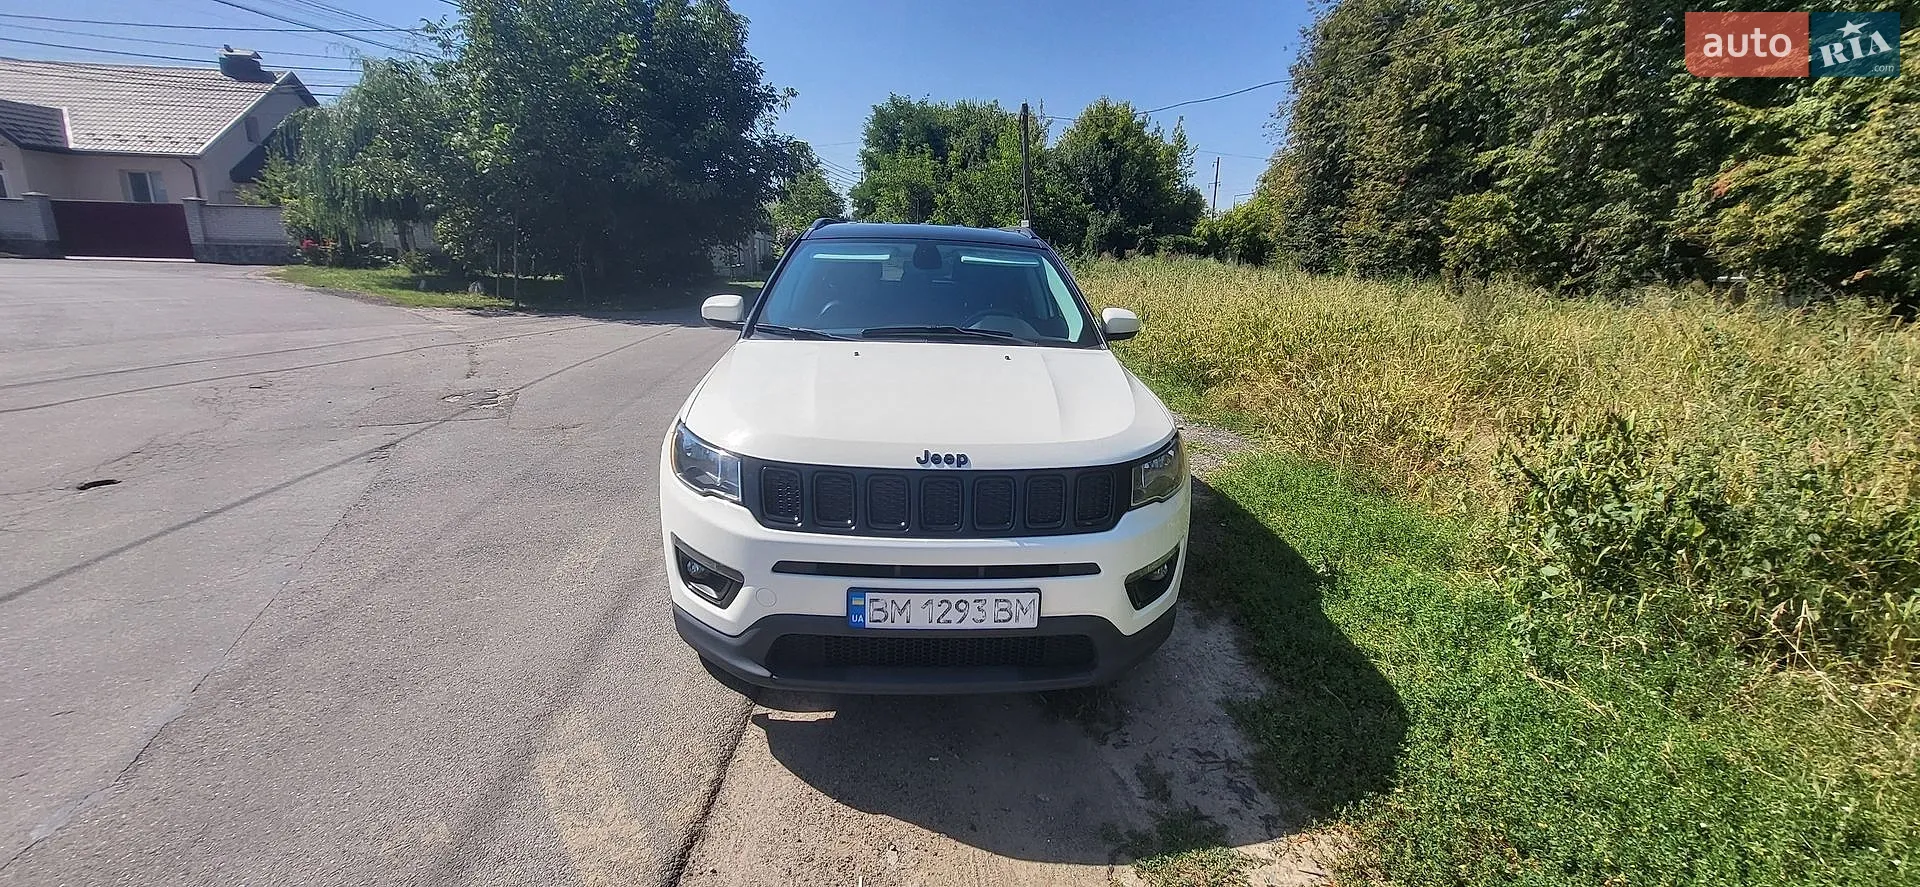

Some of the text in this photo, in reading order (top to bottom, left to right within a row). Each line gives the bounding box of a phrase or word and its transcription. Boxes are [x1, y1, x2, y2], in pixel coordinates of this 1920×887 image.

[916, 449, 969, 468] Jeep
[851, 615, 864, 624] UA
[868, 598, 1036, 624] BM 1293 BM
